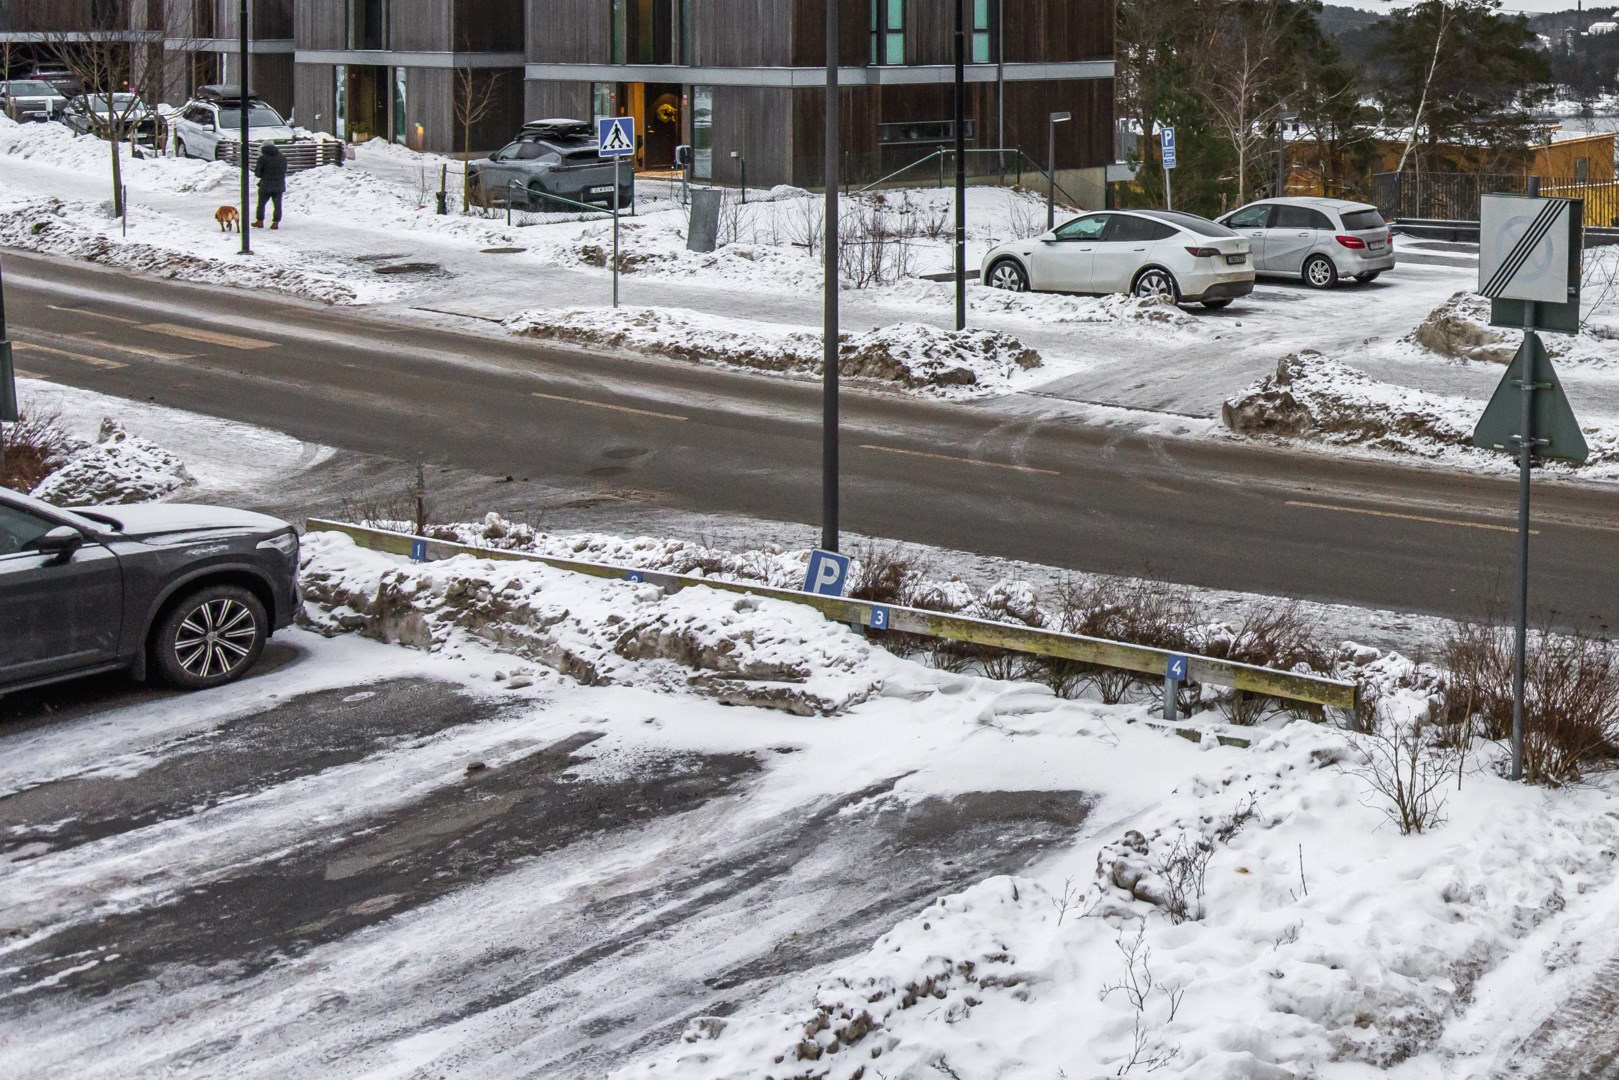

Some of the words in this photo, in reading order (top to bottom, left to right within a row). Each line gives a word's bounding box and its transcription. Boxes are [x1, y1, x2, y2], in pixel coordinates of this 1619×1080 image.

[1164, 130, 1172, 146] P
[416, 544, 421, 556] 1
[813, 557, 840, 594] P
[875, 610, 884, 625] 3
[1171, 660, 1182, 676] 4
